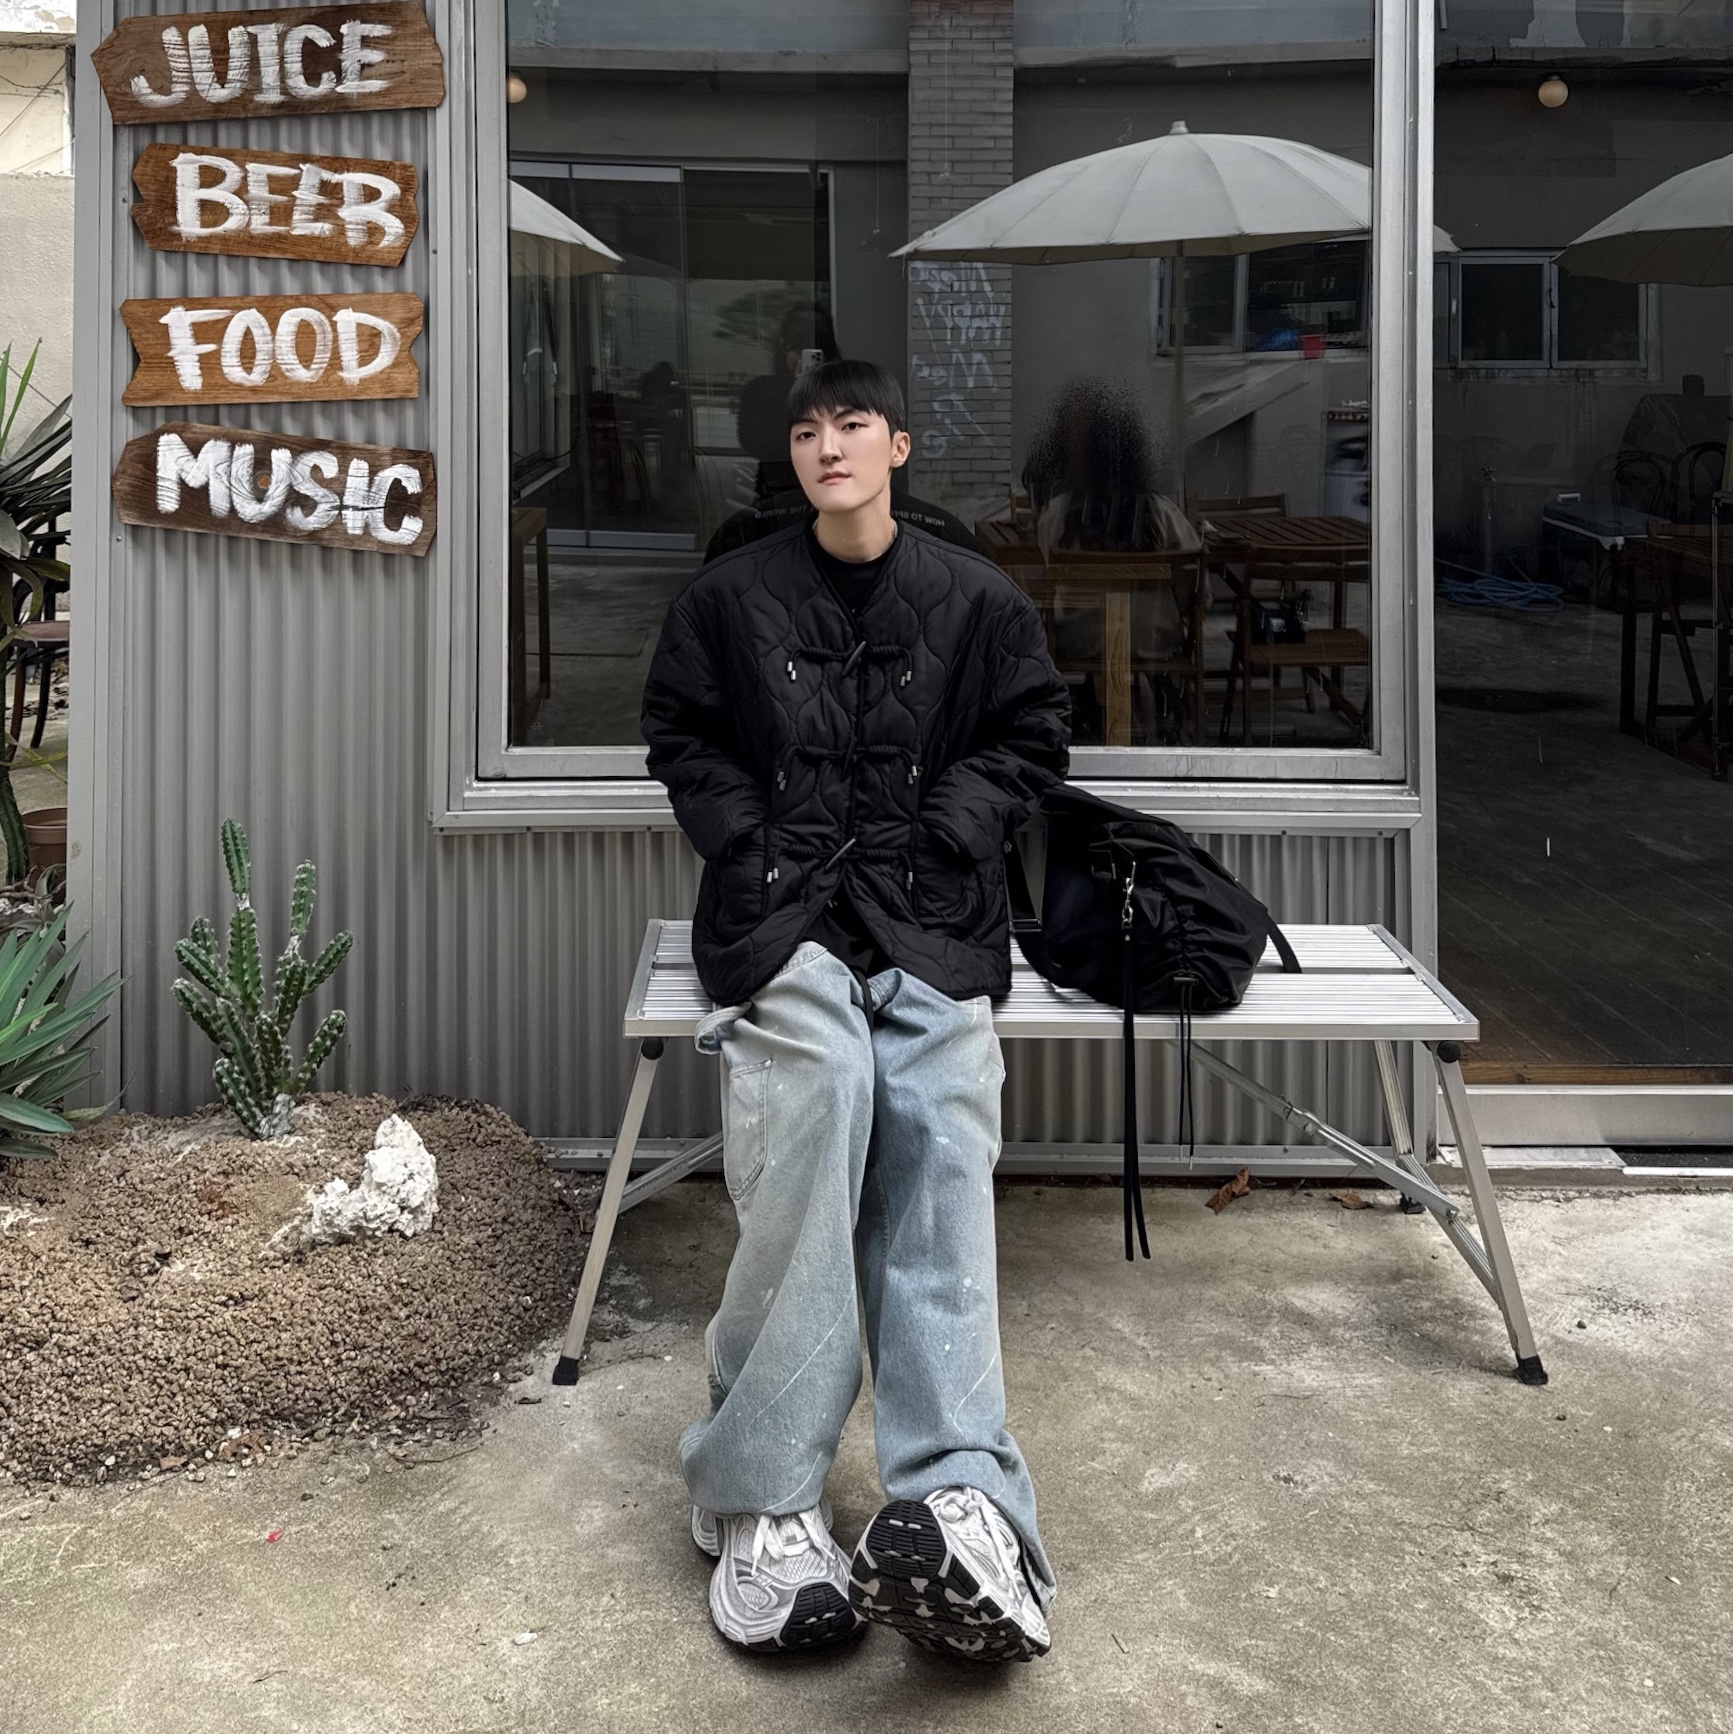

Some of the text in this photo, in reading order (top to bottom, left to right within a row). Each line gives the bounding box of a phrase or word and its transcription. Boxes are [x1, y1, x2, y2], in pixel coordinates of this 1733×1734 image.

[131, 19, 394, 107] JUICE
[169, 152, 405, 249] BEER
[159, 306, 401, 391] FOOD
[155, 432, 424, 545] MUSIC
